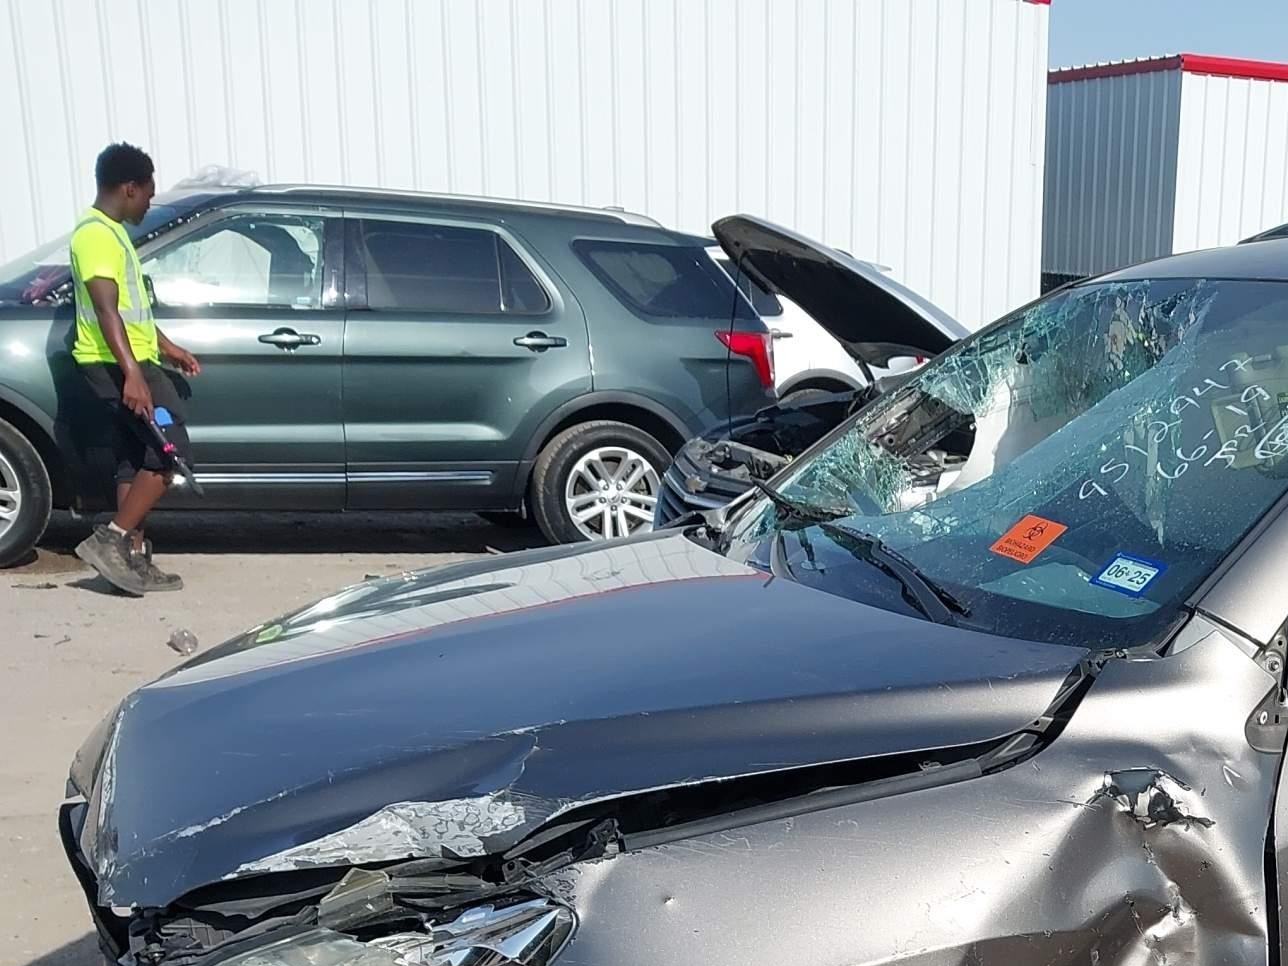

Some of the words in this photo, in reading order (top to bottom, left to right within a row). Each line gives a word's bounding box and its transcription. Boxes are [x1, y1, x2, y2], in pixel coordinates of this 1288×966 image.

[1078, 356, 1253, 500] 9512947
[1156, 384, 1271, 480] 66-19
[1107, 564, 1128, 578] 06
[1127, 570, 1151, 585] 25
